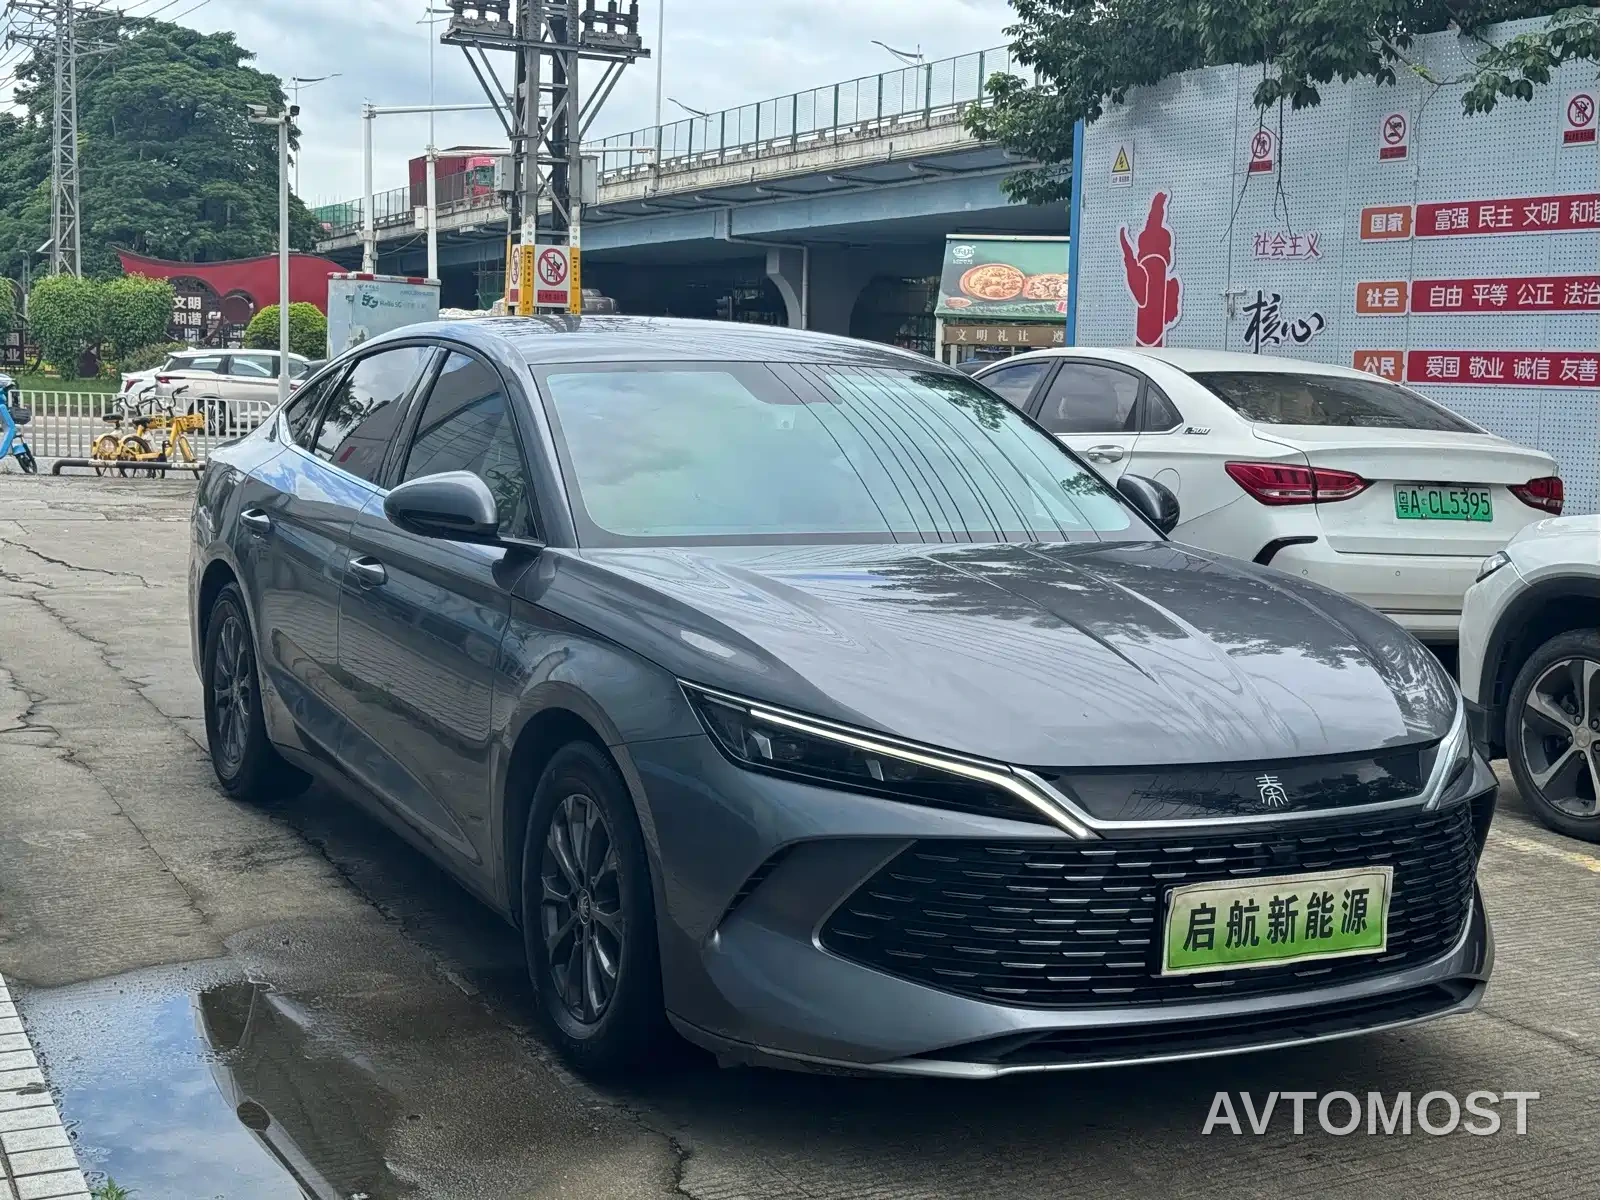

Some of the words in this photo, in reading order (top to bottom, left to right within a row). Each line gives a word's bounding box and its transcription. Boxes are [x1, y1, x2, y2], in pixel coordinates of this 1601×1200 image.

[1370, 213, 1404, 233] 国家
[1435, 207, 1469, 231] 富强
[1478, 205, 1513, 228] 民主
[1523, 202, 1559, 226] 文明
[1253, 232, 1320, 257] 社会主义
[173, 296, 201, 310] 文明
[1366, 288, 1399, 308] 社会
[1430, 286, 1462, 307] 自由
[1472, 284, 1508, 306] 平等
[1517, 283, 1554, 305] 公正
[1563, 282, 1600, 305] 法治
[173, 311, 202, 326] 和谐
[1242, 289, 1324, 354] 核心
[1363, 356, 1395, 376] 公民
[1425, 355, 1460, 378] 爱国
[1469, 356, 1504, 379] 敬业
[1513, 357, 1551, 380] 诚信
[1559, 358, 1598, 381] 友善
[1182, 887, 1370, 952] 启航新能源
